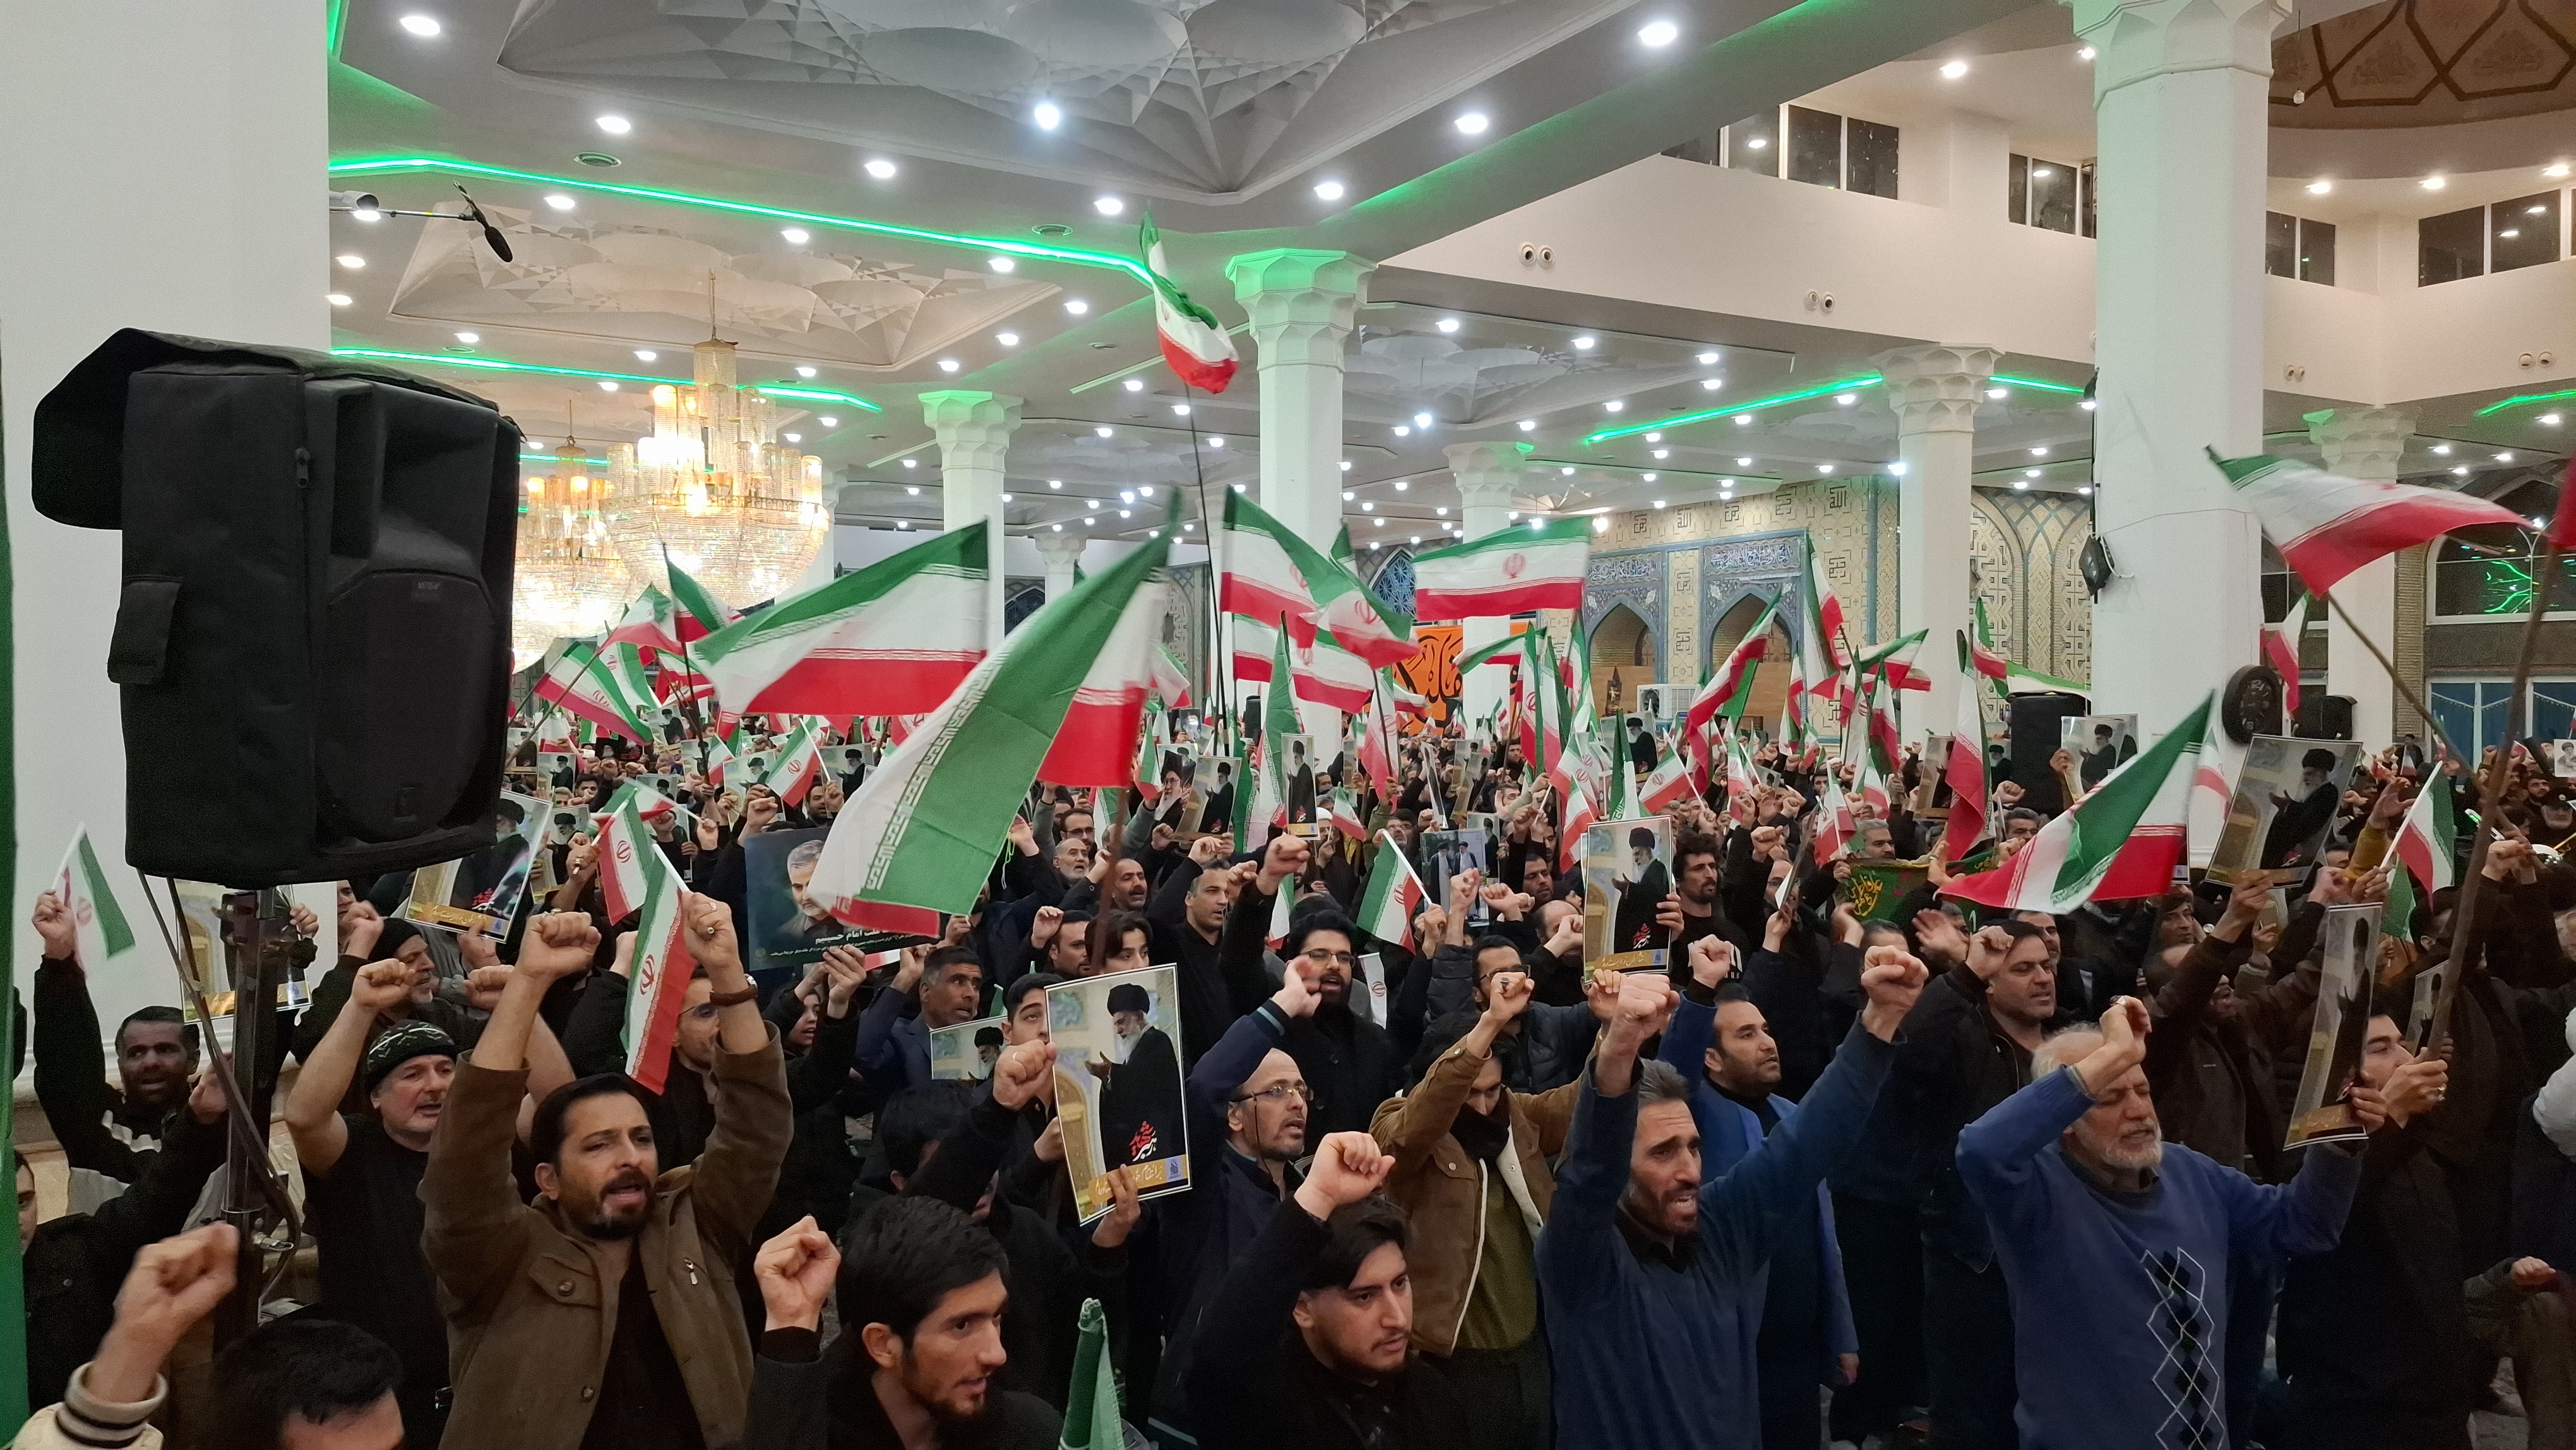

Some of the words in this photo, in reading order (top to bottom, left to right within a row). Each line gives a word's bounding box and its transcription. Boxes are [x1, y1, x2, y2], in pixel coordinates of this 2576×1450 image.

[846, 930, 862, 942] امام
[1129, 1120, 1155, 1157] شهید
[1132, 1130, 1158, 1163] رهبر
